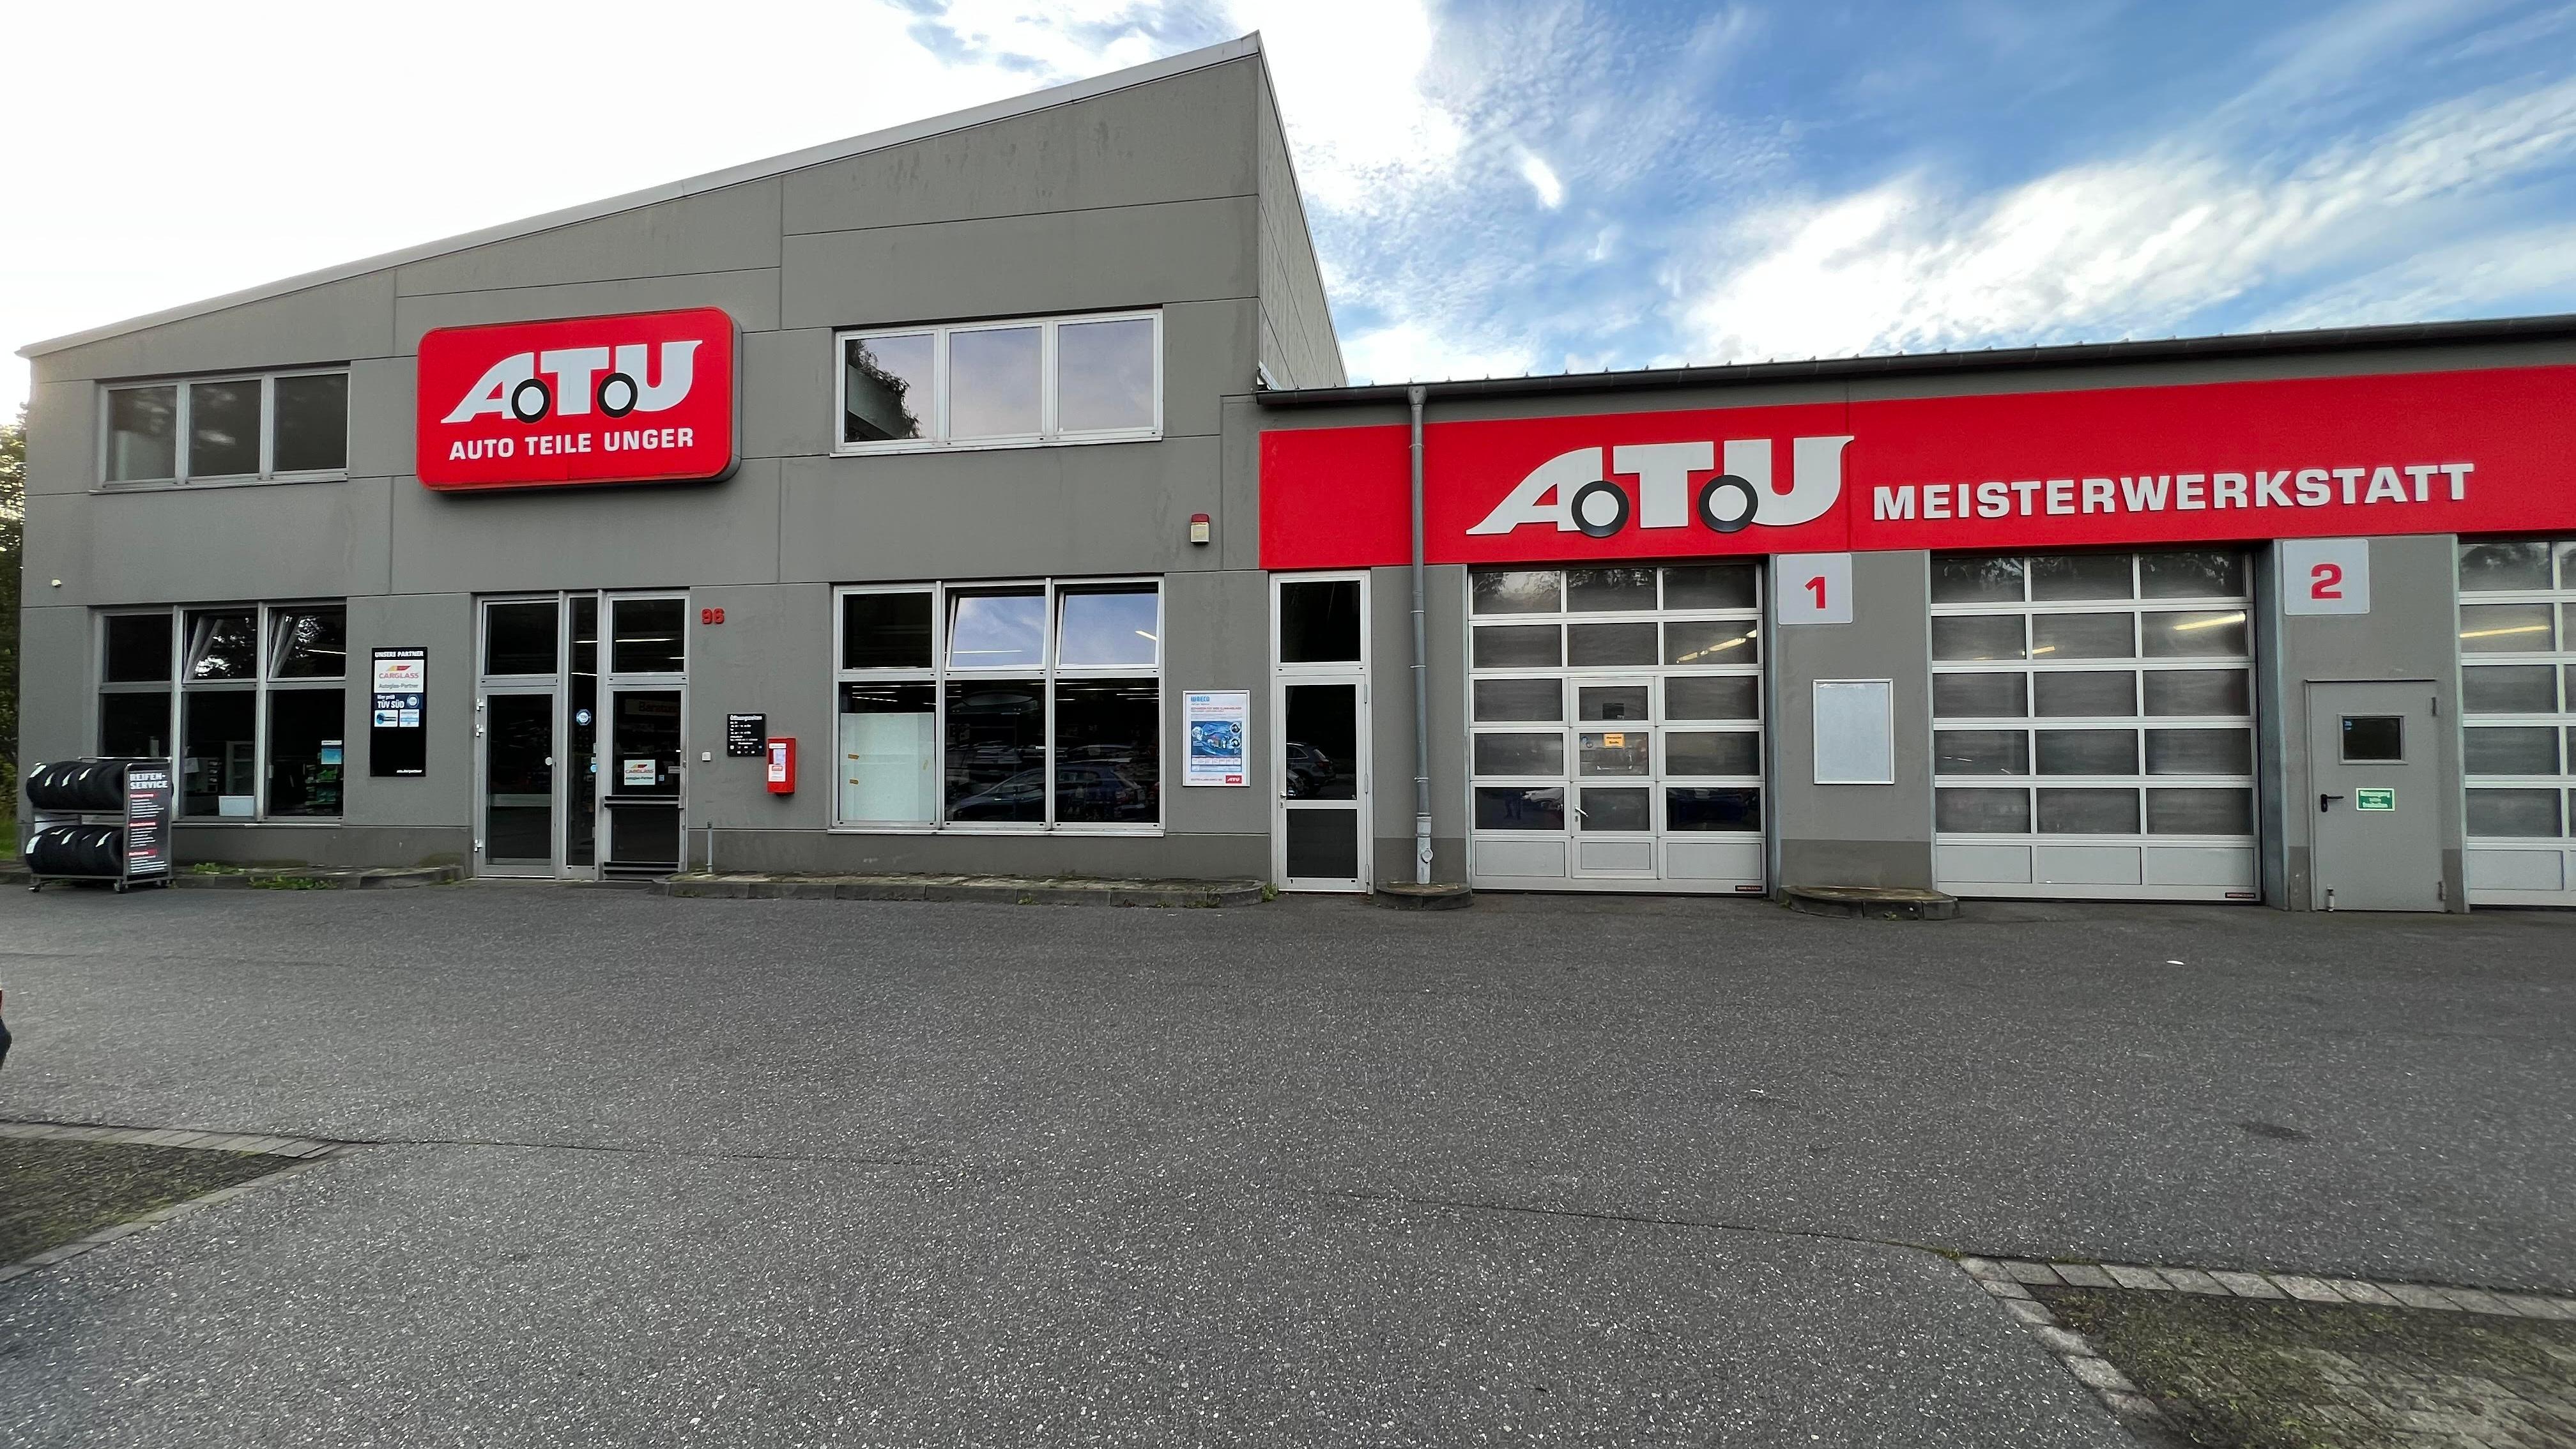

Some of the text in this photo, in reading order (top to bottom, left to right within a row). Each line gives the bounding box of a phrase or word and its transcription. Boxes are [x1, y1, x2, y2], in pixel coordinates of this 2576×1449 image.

[448, 427, 694, 461] AUTO TEILE UNGER
[1873, 463, 2474, 521] MEISTERWERKSTATT
[1804, 576, 1826, 610] 1
[2311, 563, 2342, 599] 2
[702, 608, 725, 625] 96
[377, 699, 405, 709] TÜV SÜD
[130, 772, 166, 781] REIFEN-
[130, 781, 167, 790] SERVICE
